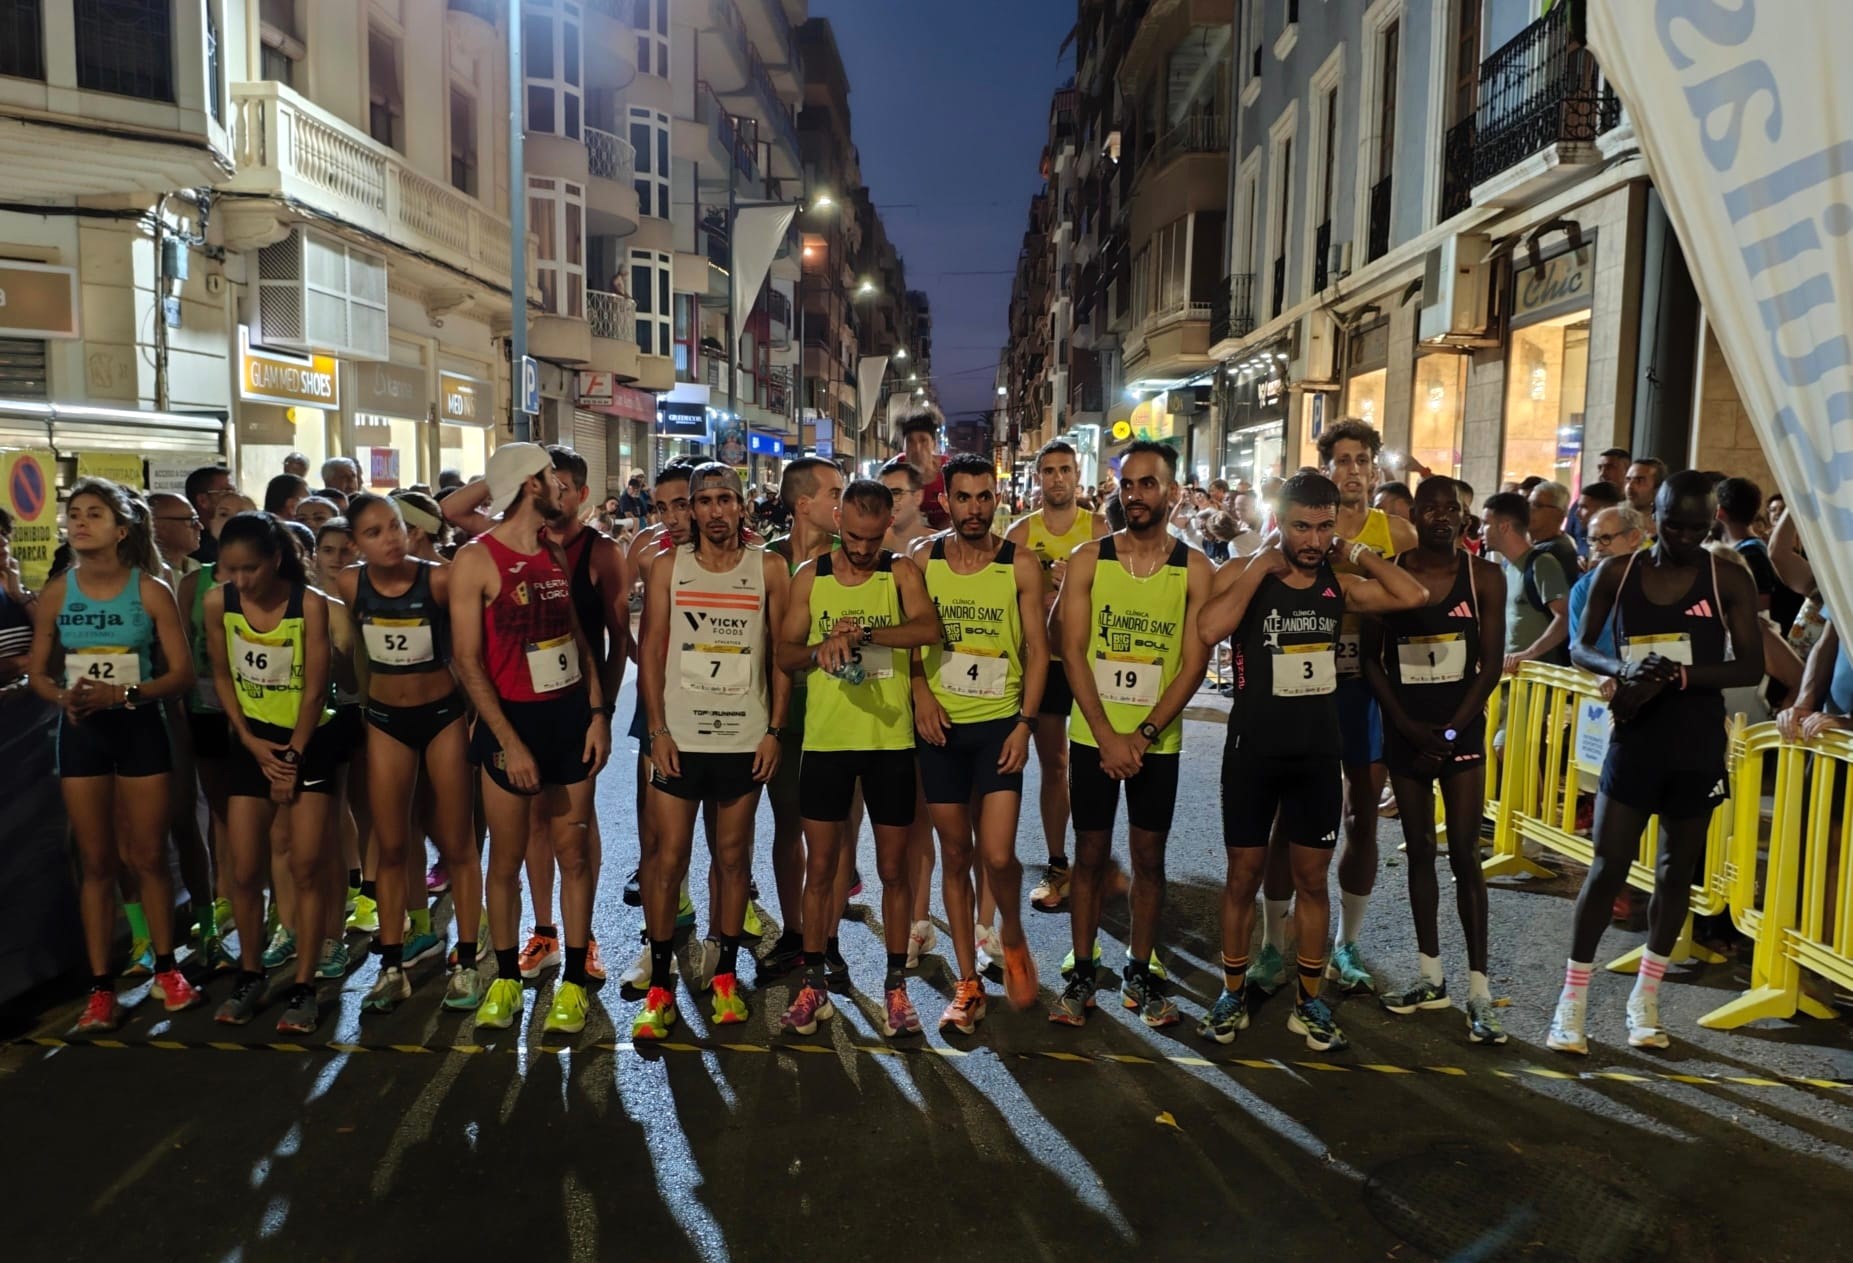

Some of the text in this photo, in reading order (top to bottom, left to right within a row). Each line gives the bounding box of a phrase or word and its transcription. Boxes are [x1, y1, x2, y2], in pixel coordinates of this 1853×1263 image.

[1523, 261, 1584, 309] Chic
[301, 371, 332, 397] SHOES
[526, 363, 536, 406] P
[12, 525, 51, 542] ROHIBIDO
[58, 611, 124, 630] nerja
[867, 614, 893, 629] SANZ
[977, 606, 1004, 622] SANZ
[709, 617, 748, 629] VICKY
[964, 627, 1000, 636] SOUL
[1098, 612, 1177, 636] ALEJANDRO SANZ
[1263, 617, 1317, 633] ALEJANDRO
[713, 628, 744, 636] FOODS
[384, 634, 408, 651] 52
[1134, 638, 1170, 650] SOUL
[244, 650, 268, 670] 46
[558, 653, 568, 671] 9
[1428, 651, 1436, 667] 1
[88, 661, 115, 679] 42
[290, 664, 304, 678] NZ
[710, 661, 721, 678] 7
[967, 663, 979, 681] 4
[1303, 661, 1314, 679] 3
[1114, 669, 1137, 688] 19
